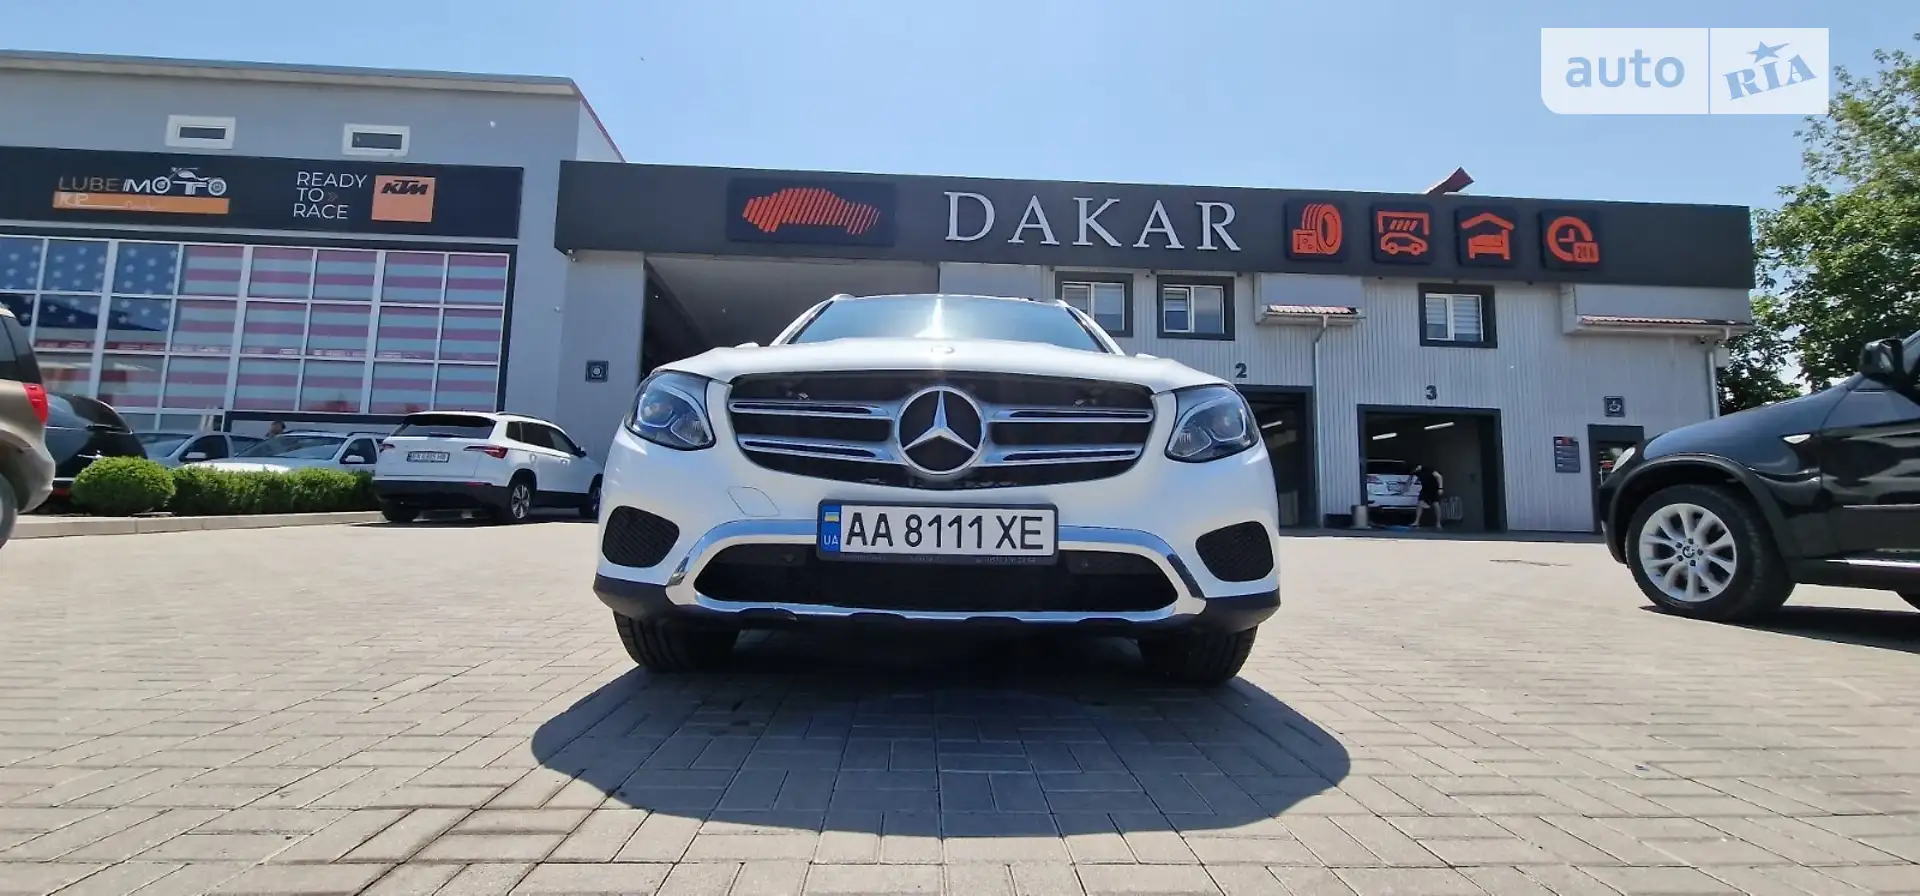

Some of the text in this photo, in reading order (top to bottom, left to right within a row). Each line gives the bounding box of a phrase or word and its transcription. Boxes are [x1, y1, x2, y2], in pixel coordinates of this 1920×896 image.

[296, 171, 367, 188] READY
[380, 179, 428, 195] KTM
[297, 187, 325, 203] TO
[293, 203, 349, 219] RACE
[944, 191, 1242, 252] DAKAR
[1235, 362, 1248, 379] 2
[1426, 385, 1437, 400] 3
[846, 512, 1044, 550] AA 8111 XE
[823, 535, 839, 546] UA
